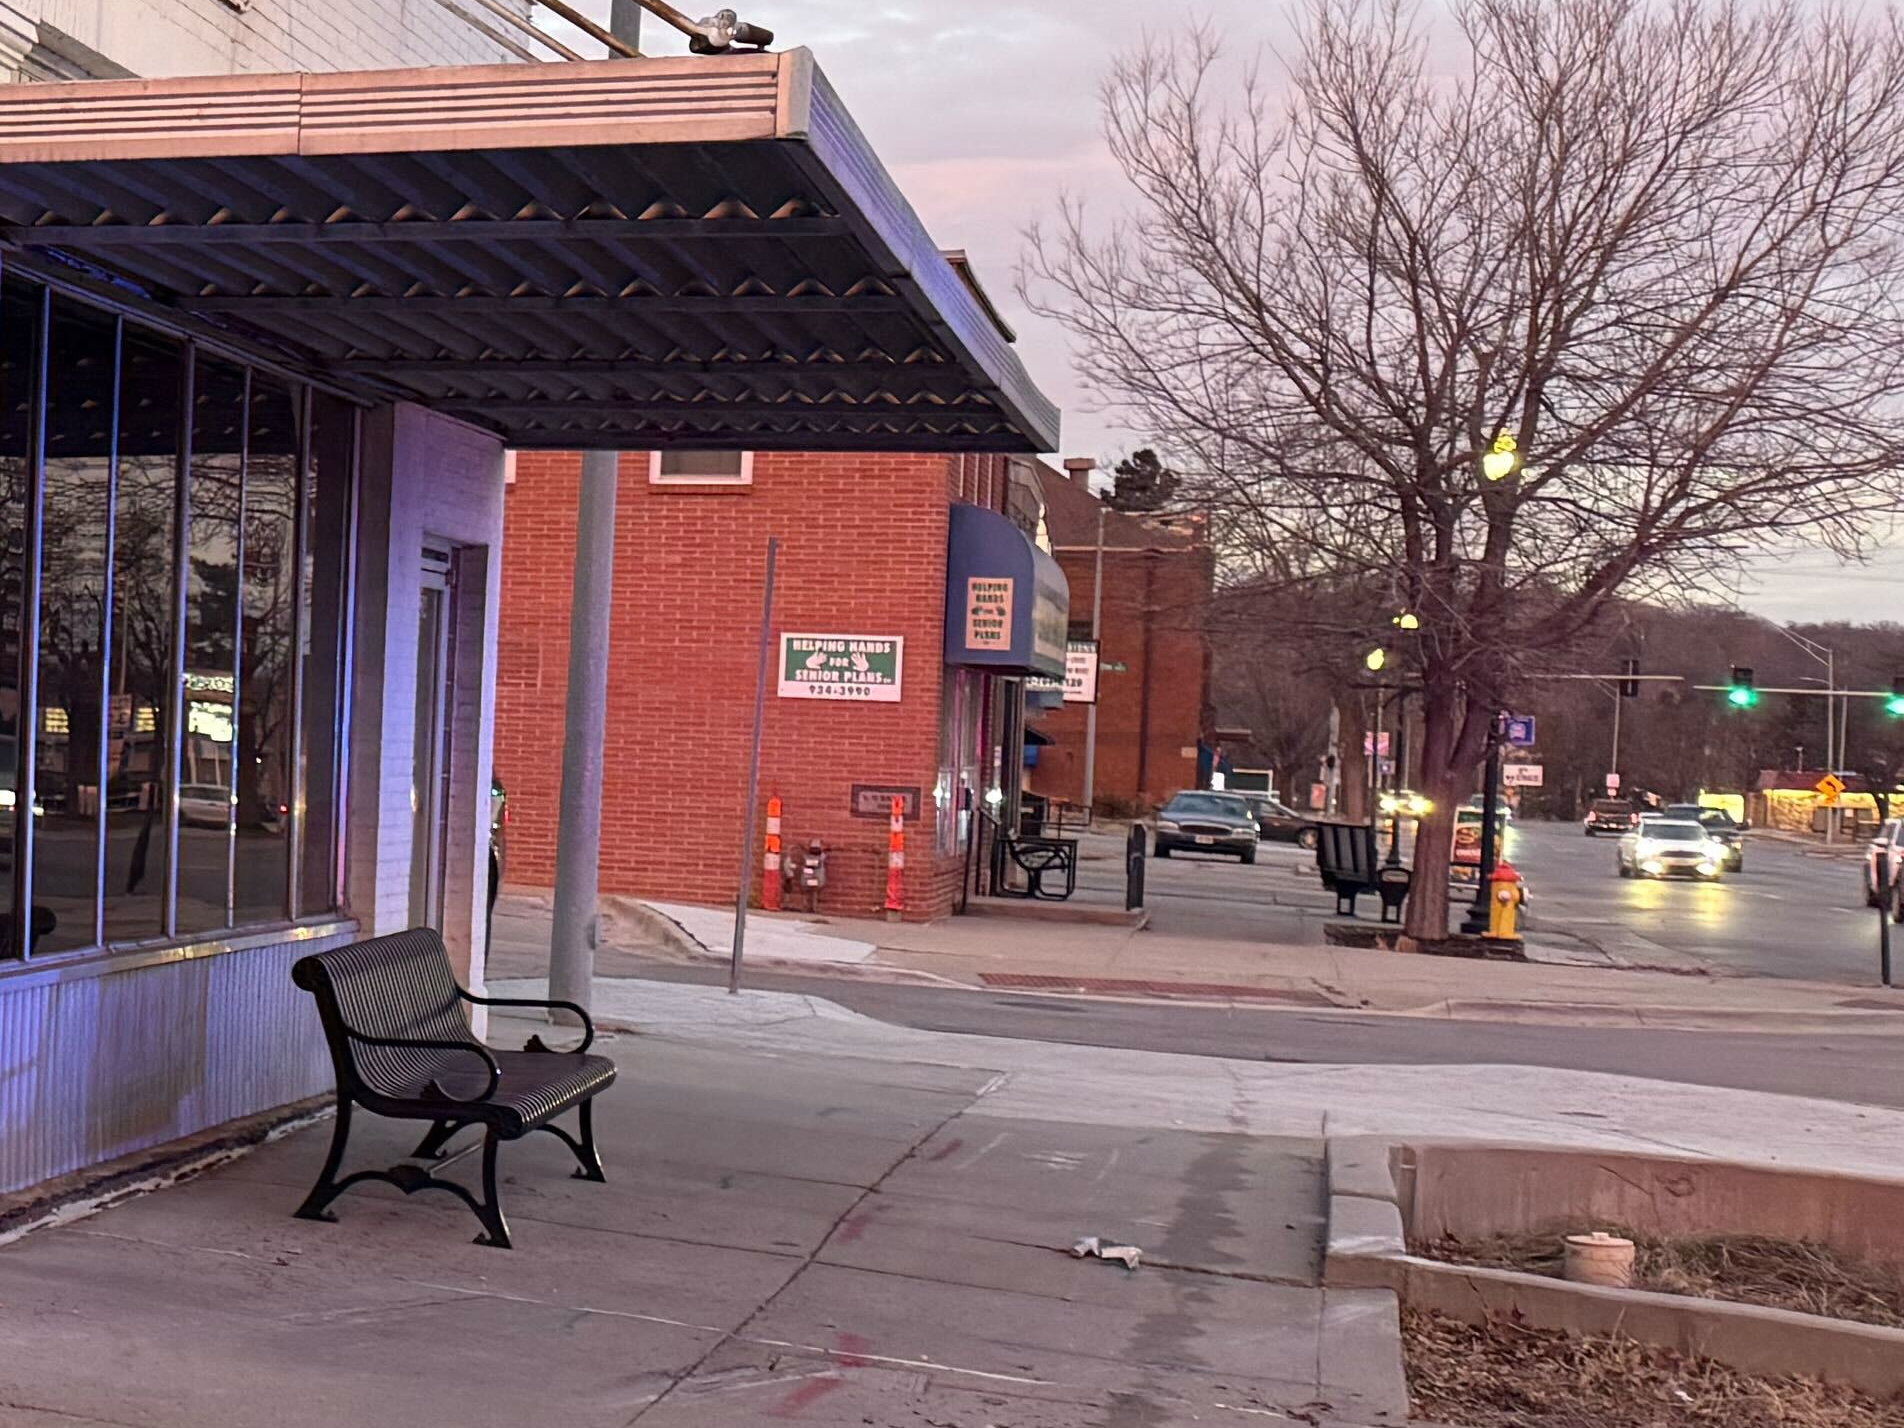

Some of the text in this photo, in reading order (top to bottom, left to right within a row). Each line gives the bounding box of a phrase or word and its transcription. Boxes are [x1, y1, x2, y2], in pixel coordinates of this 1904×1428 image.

[792, 639, 891, 654] HELPING HANDS
[829, 657, 850, 667] FOR
[795, 669, 840, 682] SENIOR
[843, 671, 883, 684] PLANS
